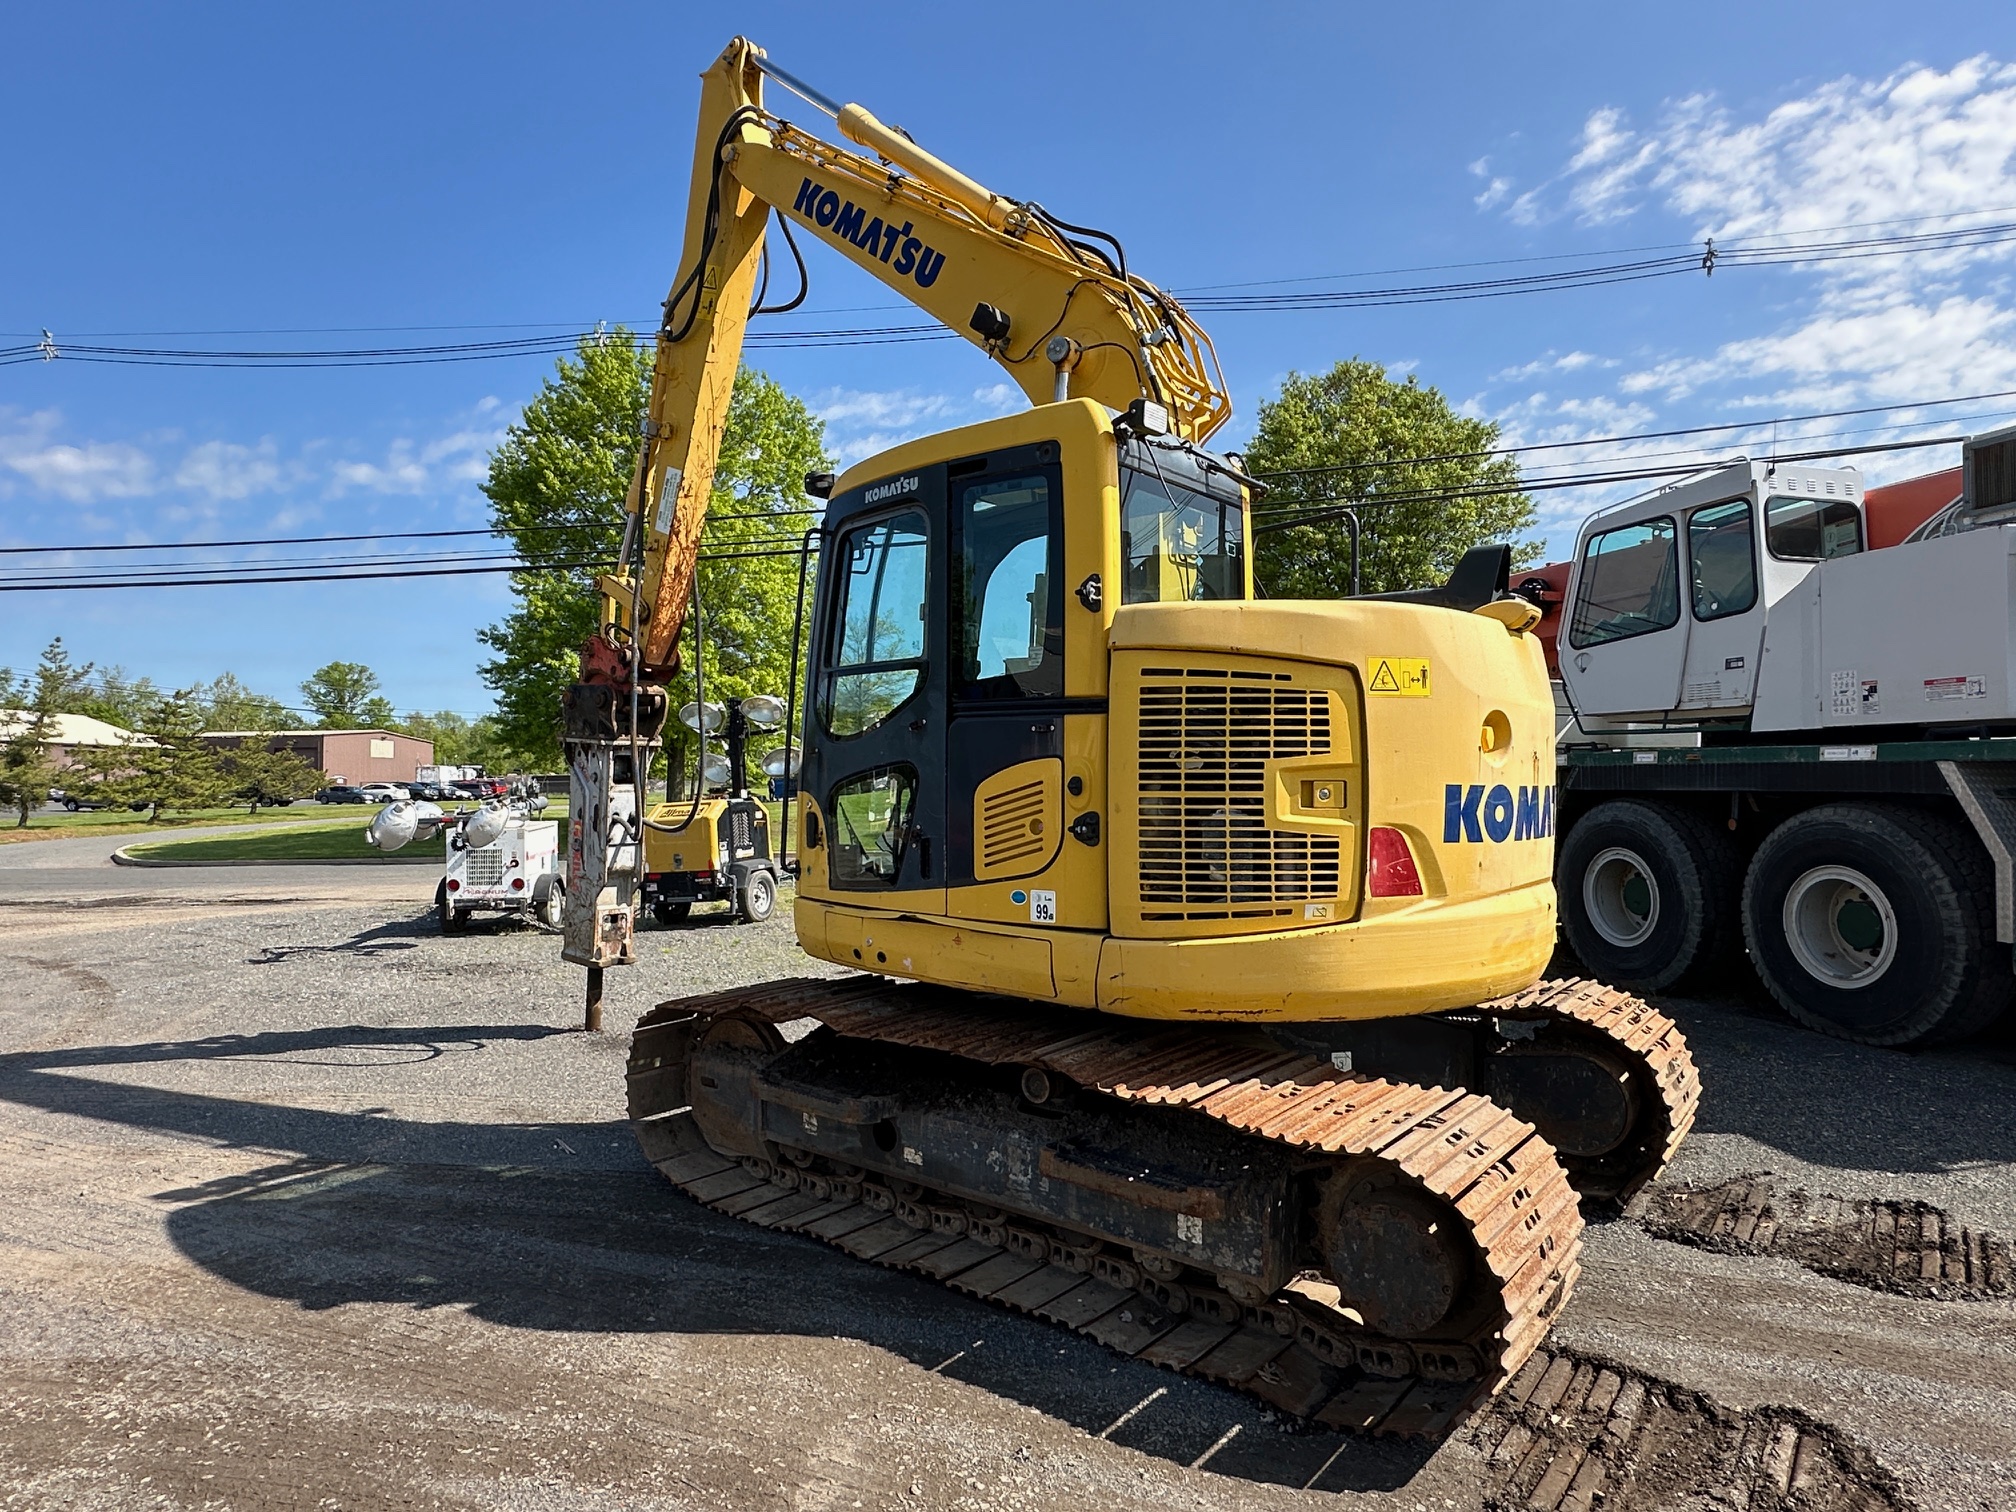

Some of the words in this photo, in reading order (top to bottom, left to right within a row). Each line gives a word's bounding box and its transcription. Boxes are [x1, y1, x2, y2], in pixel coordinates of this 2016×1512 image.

[793, 177, 946, 288] KOMATSU
[865, 477, 919, 504] KOMATSU
[1036, 903, 1048, 920] 99
